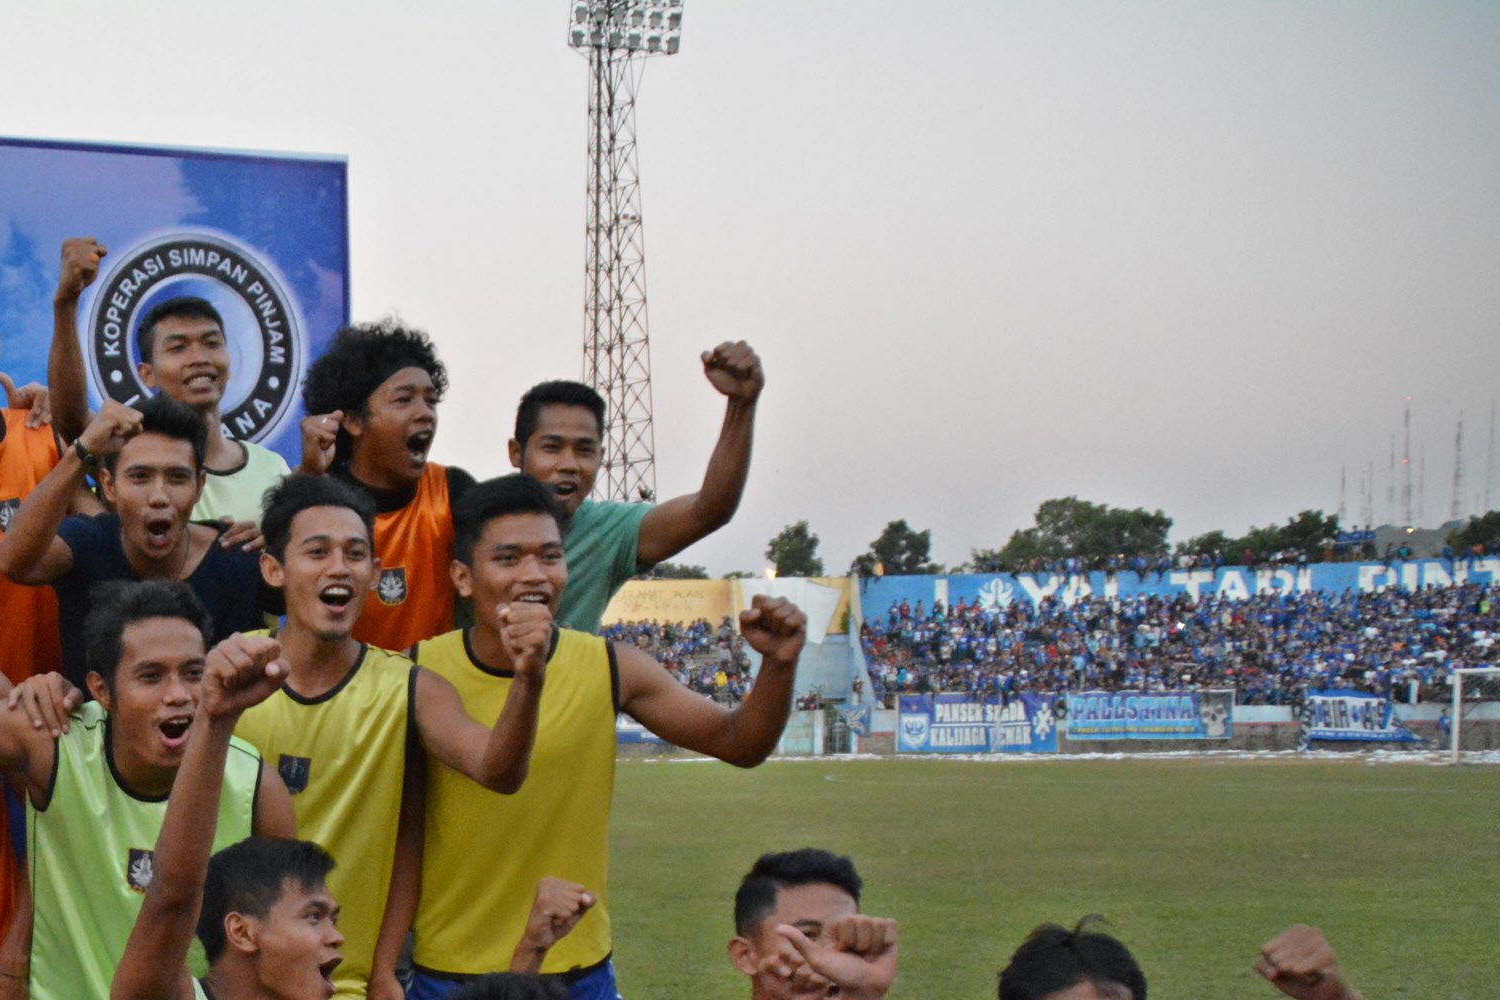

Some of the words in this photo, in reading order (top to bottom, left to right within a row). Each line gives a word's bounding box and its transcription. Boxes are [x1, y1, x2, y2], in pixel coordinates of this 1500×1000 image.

[104, 254, 166, 357] KOPERASI
[168, 248, 248, 285] SIMPAN
[246, 281, 285, 364] PINJAM
